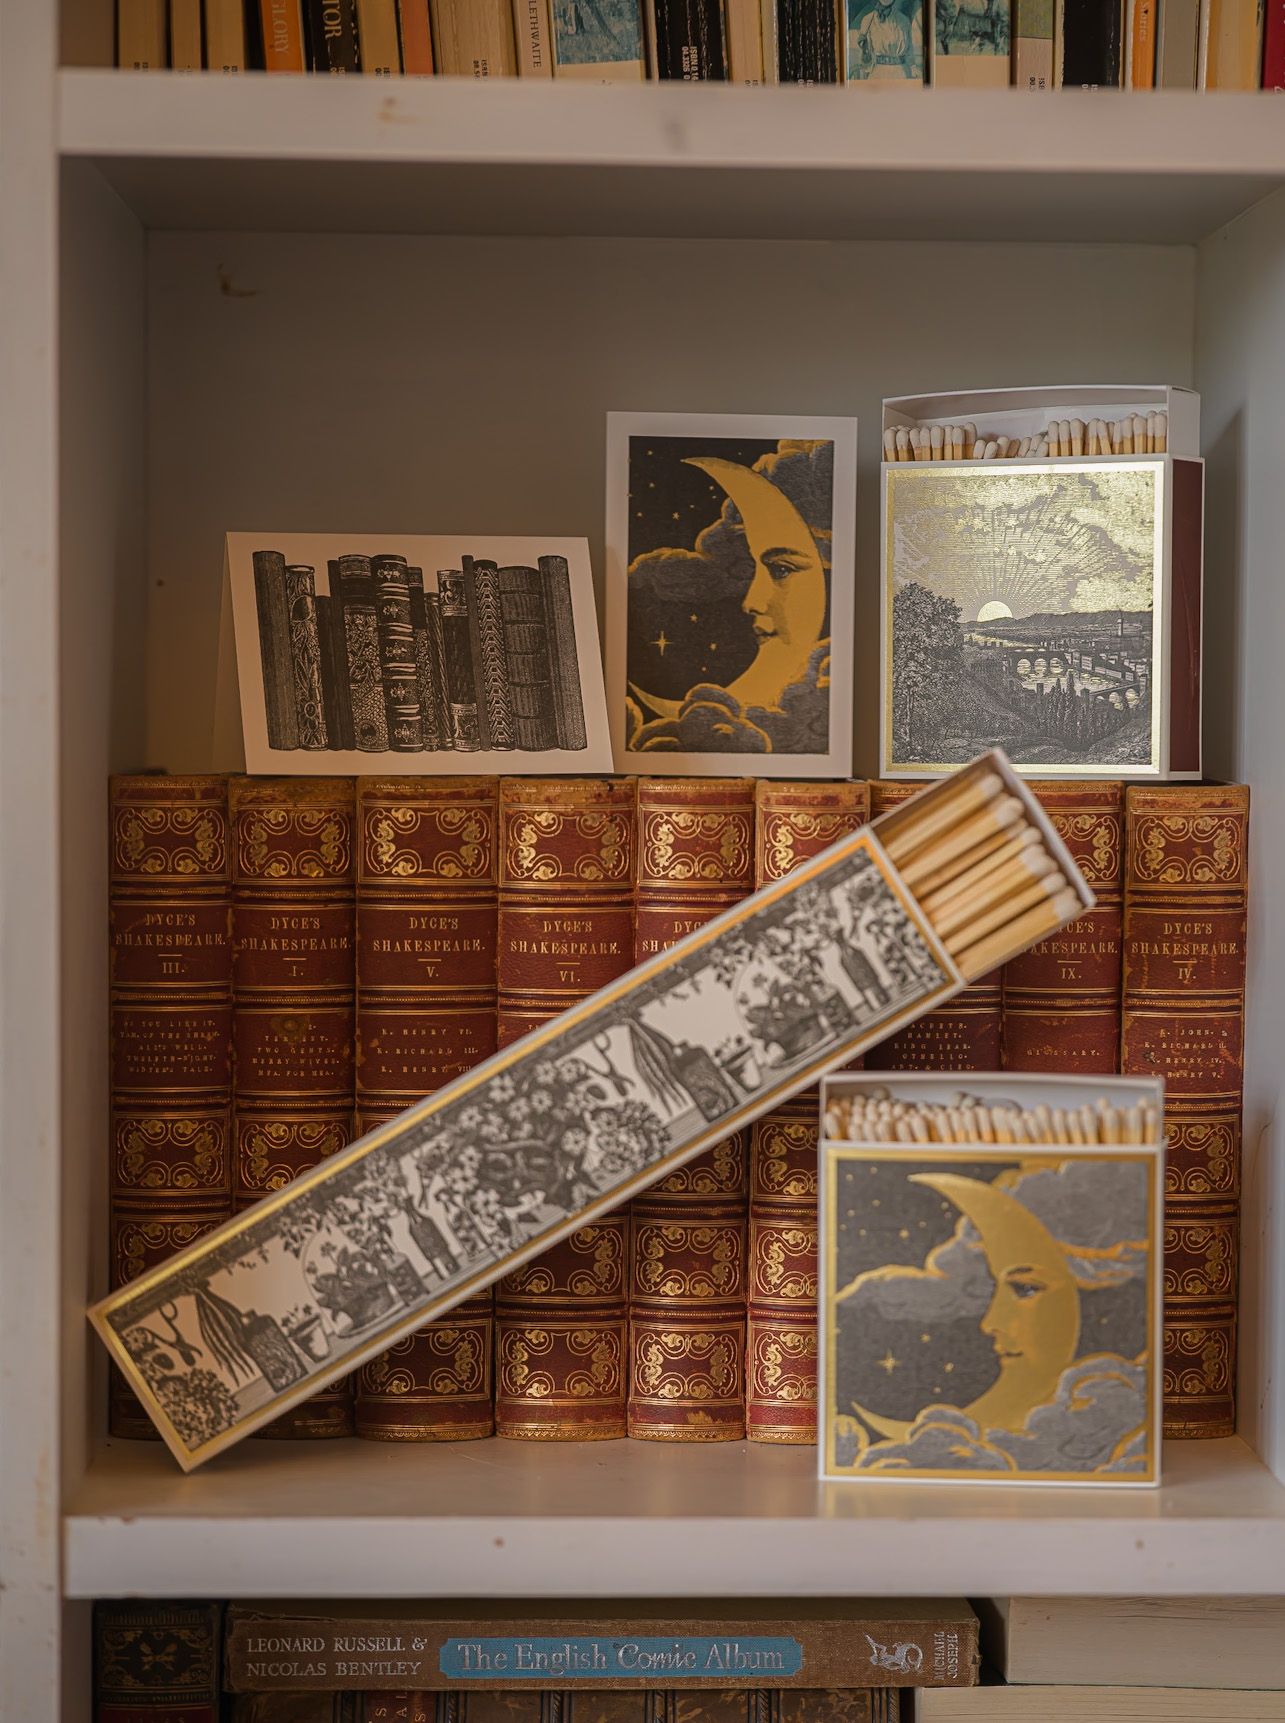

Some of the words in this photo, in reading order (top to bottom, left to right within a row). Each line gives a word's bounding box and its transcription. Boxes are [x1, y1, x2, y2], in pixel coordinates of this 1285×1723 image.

[145, 913, 196, 926] DYCE'S
[271, 917, 320, 930] DYCE'S
[409, 917, 458, 929] DYCE'S
[543, 920, 592, 933] DYCE'S
[1164, 922, 1213, 935] DYCE'S
[373, 939, 486, 952] SHAKESPEARE.
[510, 941, 621, 954] SHAKESPEARE.
[162, 962, 185, 974] III.
[290, 966, 304, 977] I.
[426, 966, 439, 978] V.
[1061, 967, 1082, 979] IX.
[1178, 967, 1197, 980] IV.
[560, 970, 581, 982] VI.
[247, 1638, 326, 1653] LEONARD
[333, 1636, 406, 1652] RUSSELL
[411, 1637, 428, 1651] &
[457, 1644, 508, 1670] The
[514, 1643, 608, 1676] English
[617, 1643, 697, 1670] Comic
[703, 1643, 785, 1669] Album
[933, 1631, 945, 1680] MICHAEL
[947, 1633, 959, 1679] JOSEPH
[247, 1661, 327, 1676] NICOLAS
[335, 1661, 422, 1676] BENTLEY
